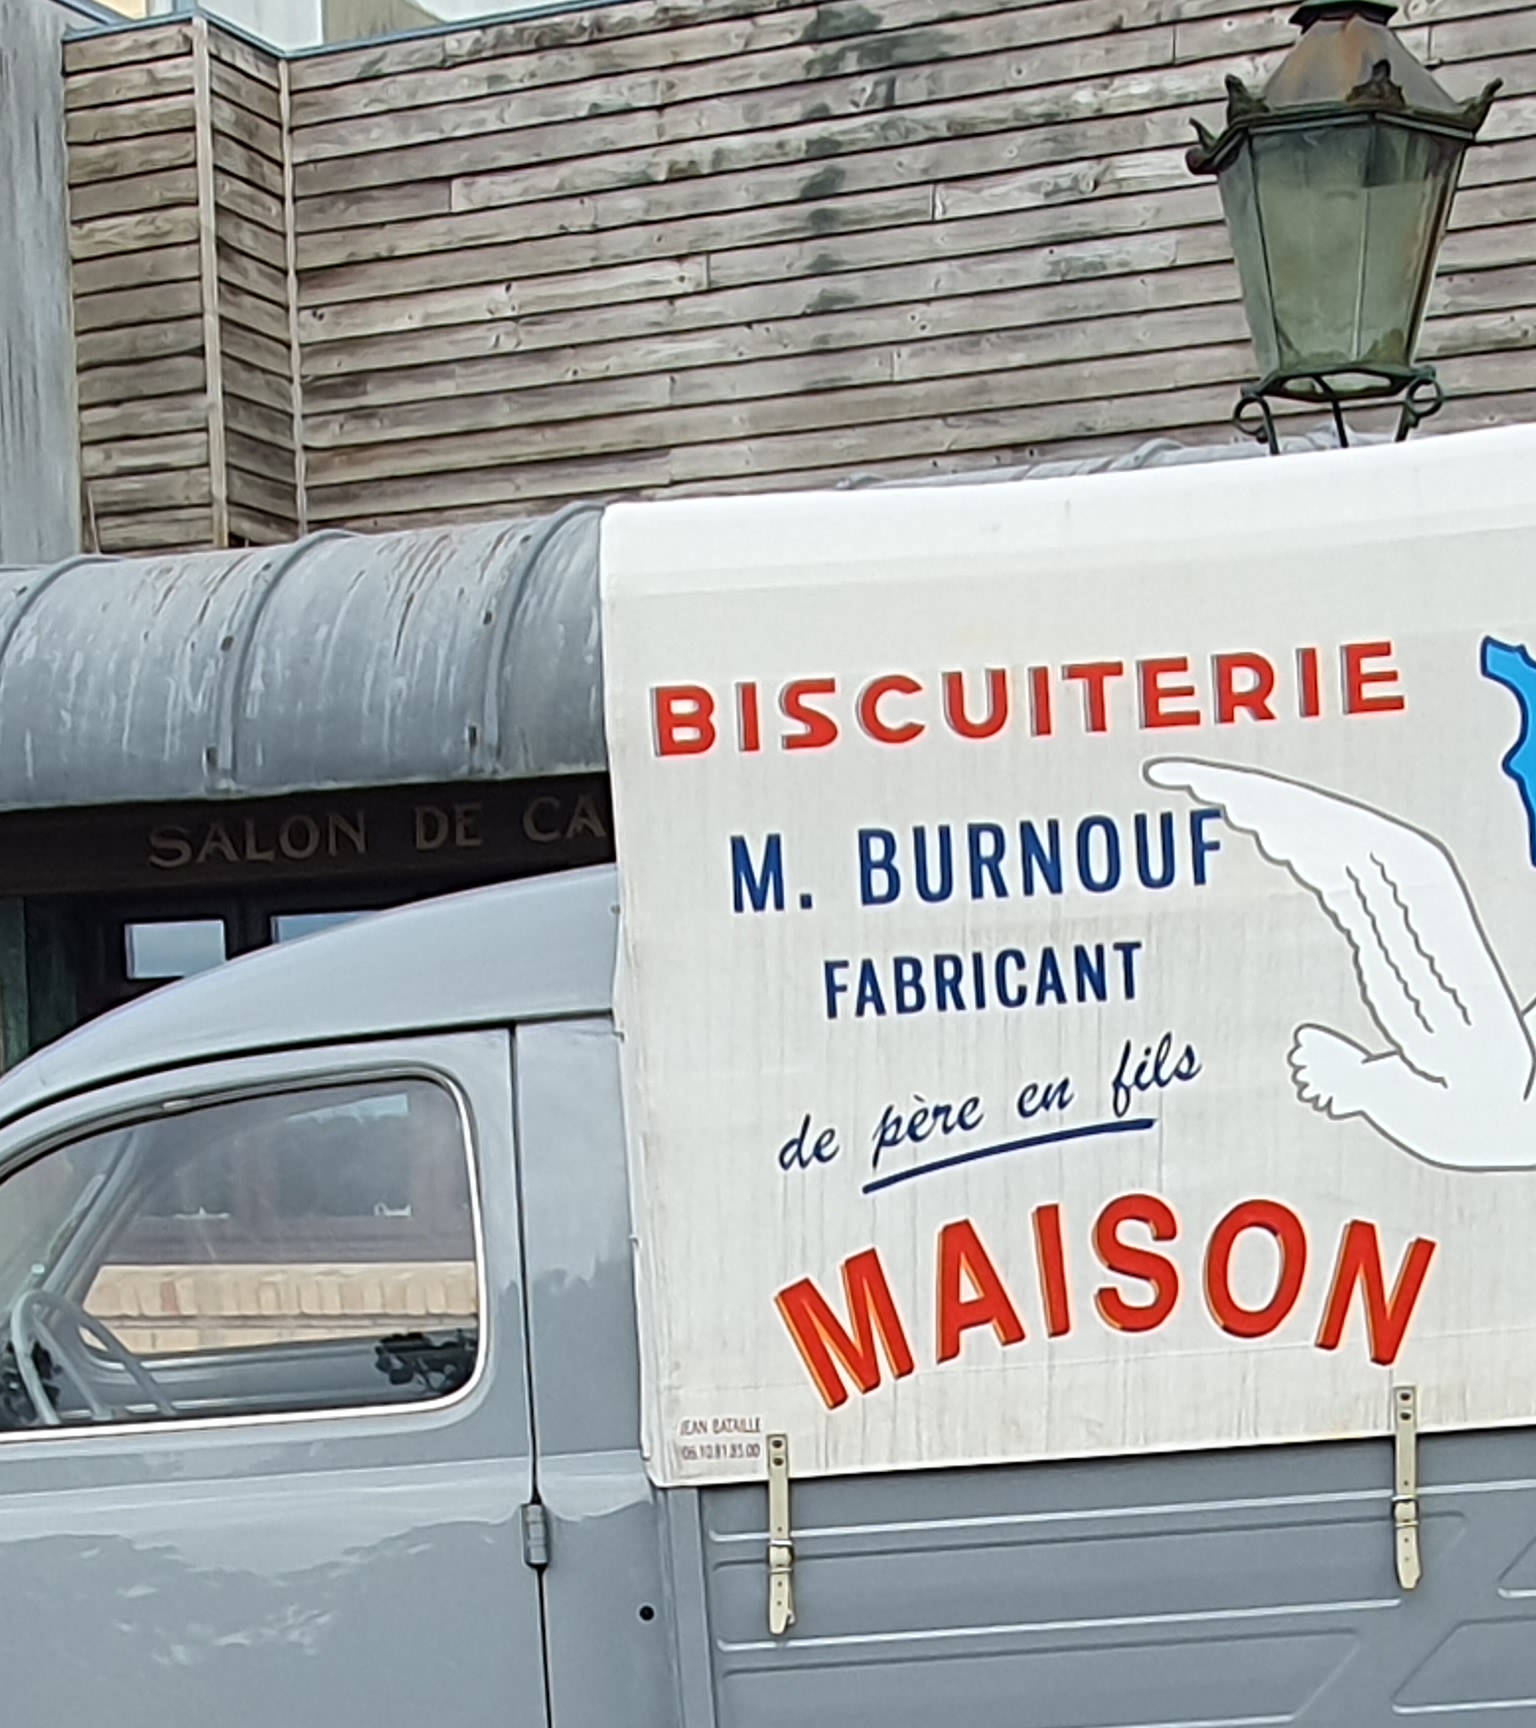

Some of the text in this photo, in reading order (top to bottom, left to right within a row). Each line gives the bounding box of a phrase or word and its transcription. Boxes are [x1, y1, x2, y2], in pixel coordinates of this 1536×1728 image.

[650, 641, 1407, 758] BISCUITERIE
[147, 811, 367, 868] SALON
[413, 803, 483, 851] DE
[729, 807, 1225, 914] M. BURNOUF
[823, 940, 1143, 1020] FABRICANT
[777, 1030, 1202, 1171] de père en fils
[774, 1192, 1438, 1410] MAISON
